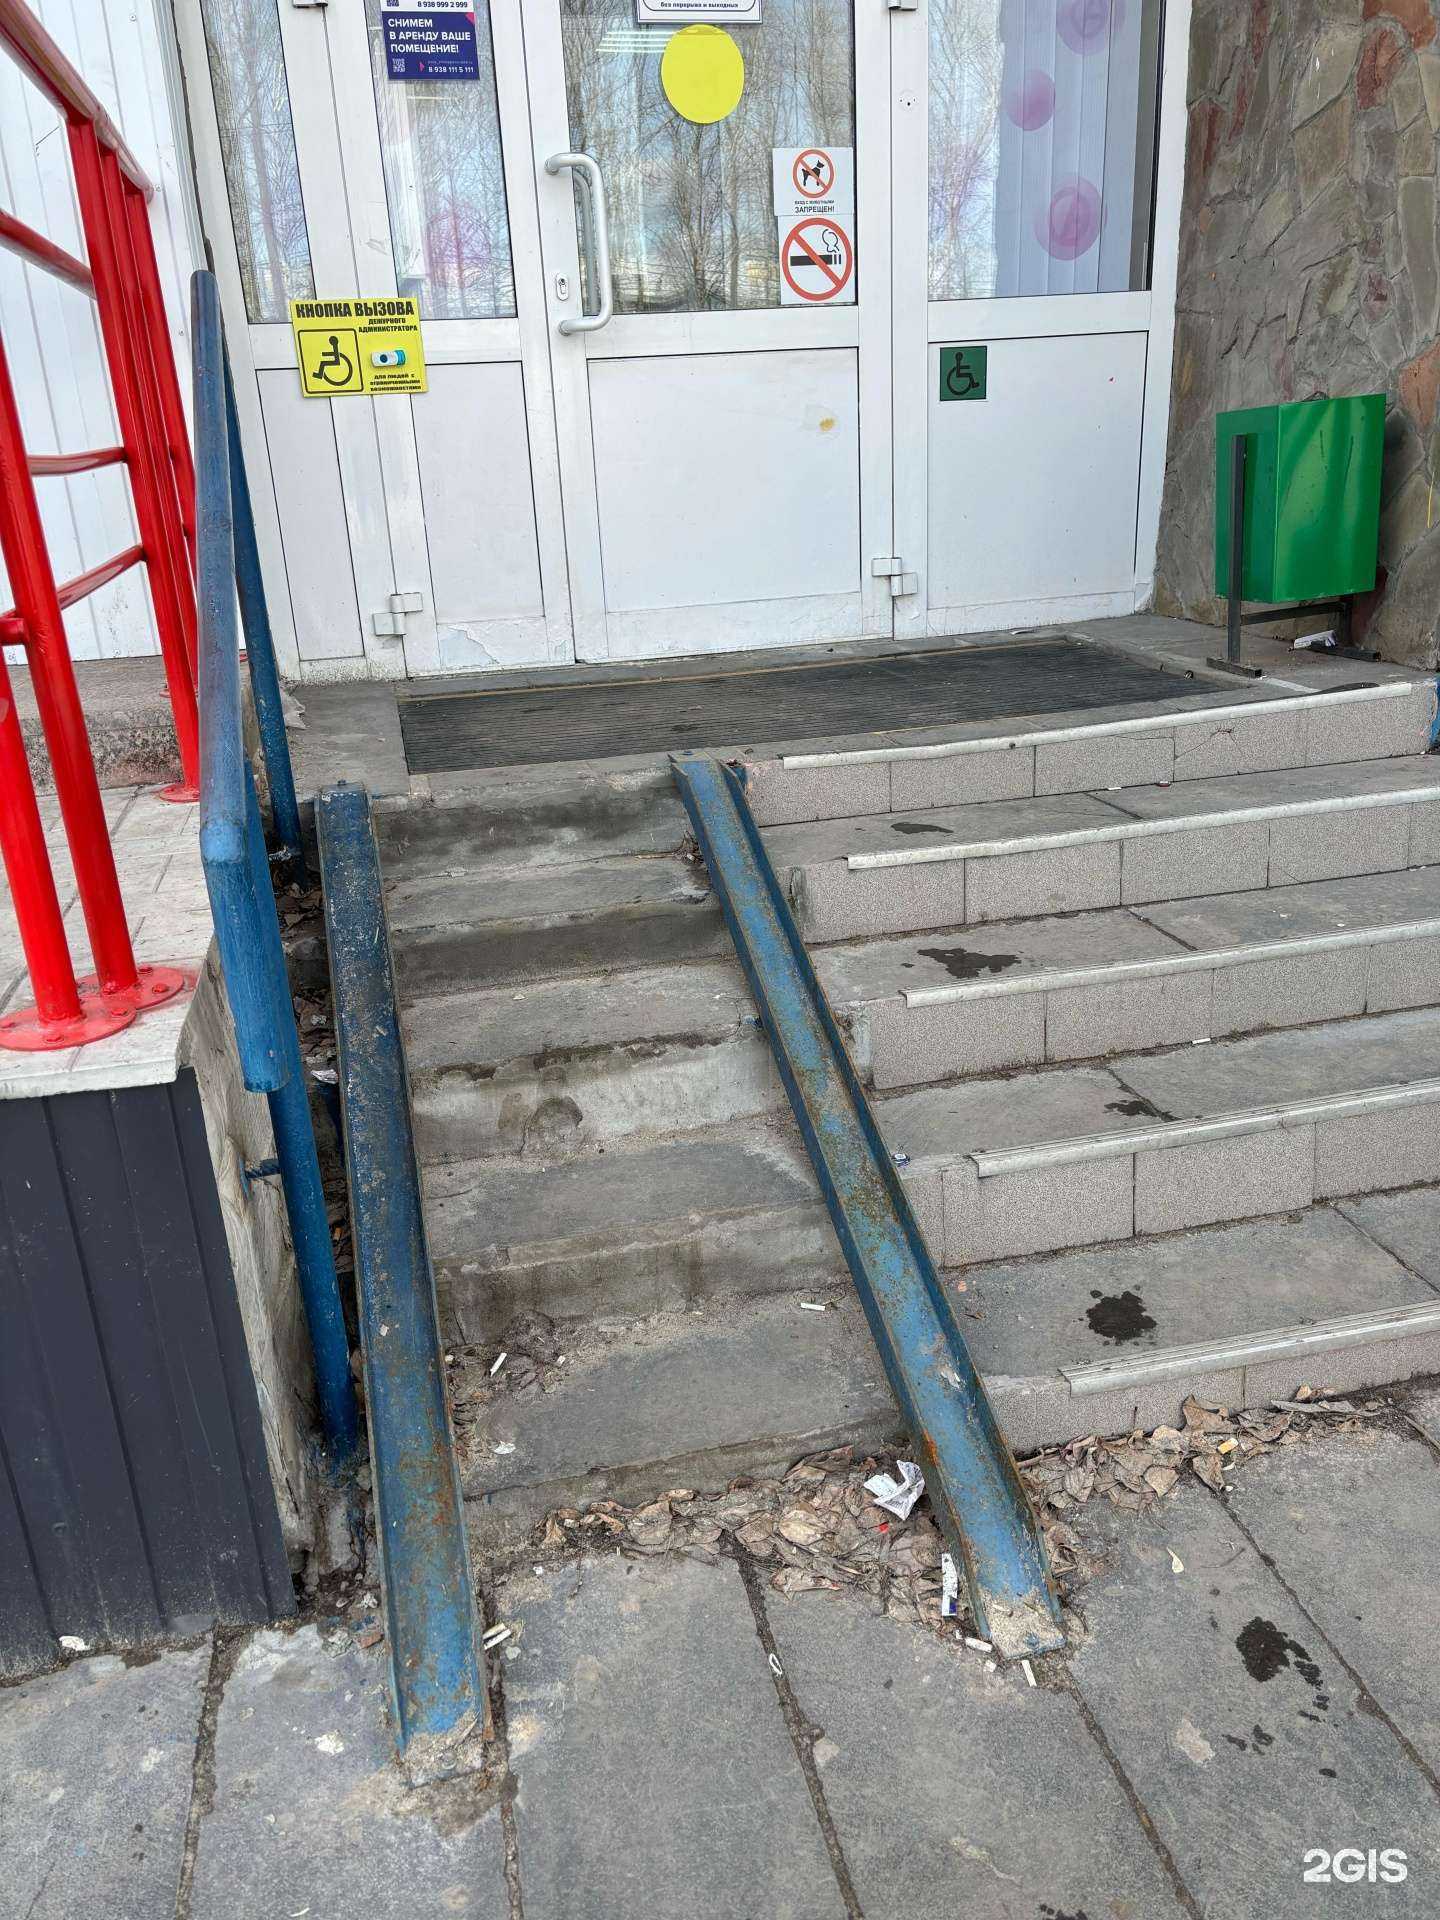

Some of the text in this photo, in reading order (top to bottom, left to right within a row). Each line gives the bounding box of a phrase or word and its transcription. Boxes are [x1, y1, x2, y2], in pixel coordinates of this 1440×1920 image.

[388, 19, 432, 27] СНИМЕМ
[399, 32, 438, 41] АРЕНДУ
[442, 32, 471, 40] ВАШЕ
[391, 44, 459, 54] ПОМЕЩЕНИЕ!
[296, 301, 414, 318] КНОПКА ВЫЗОВА
